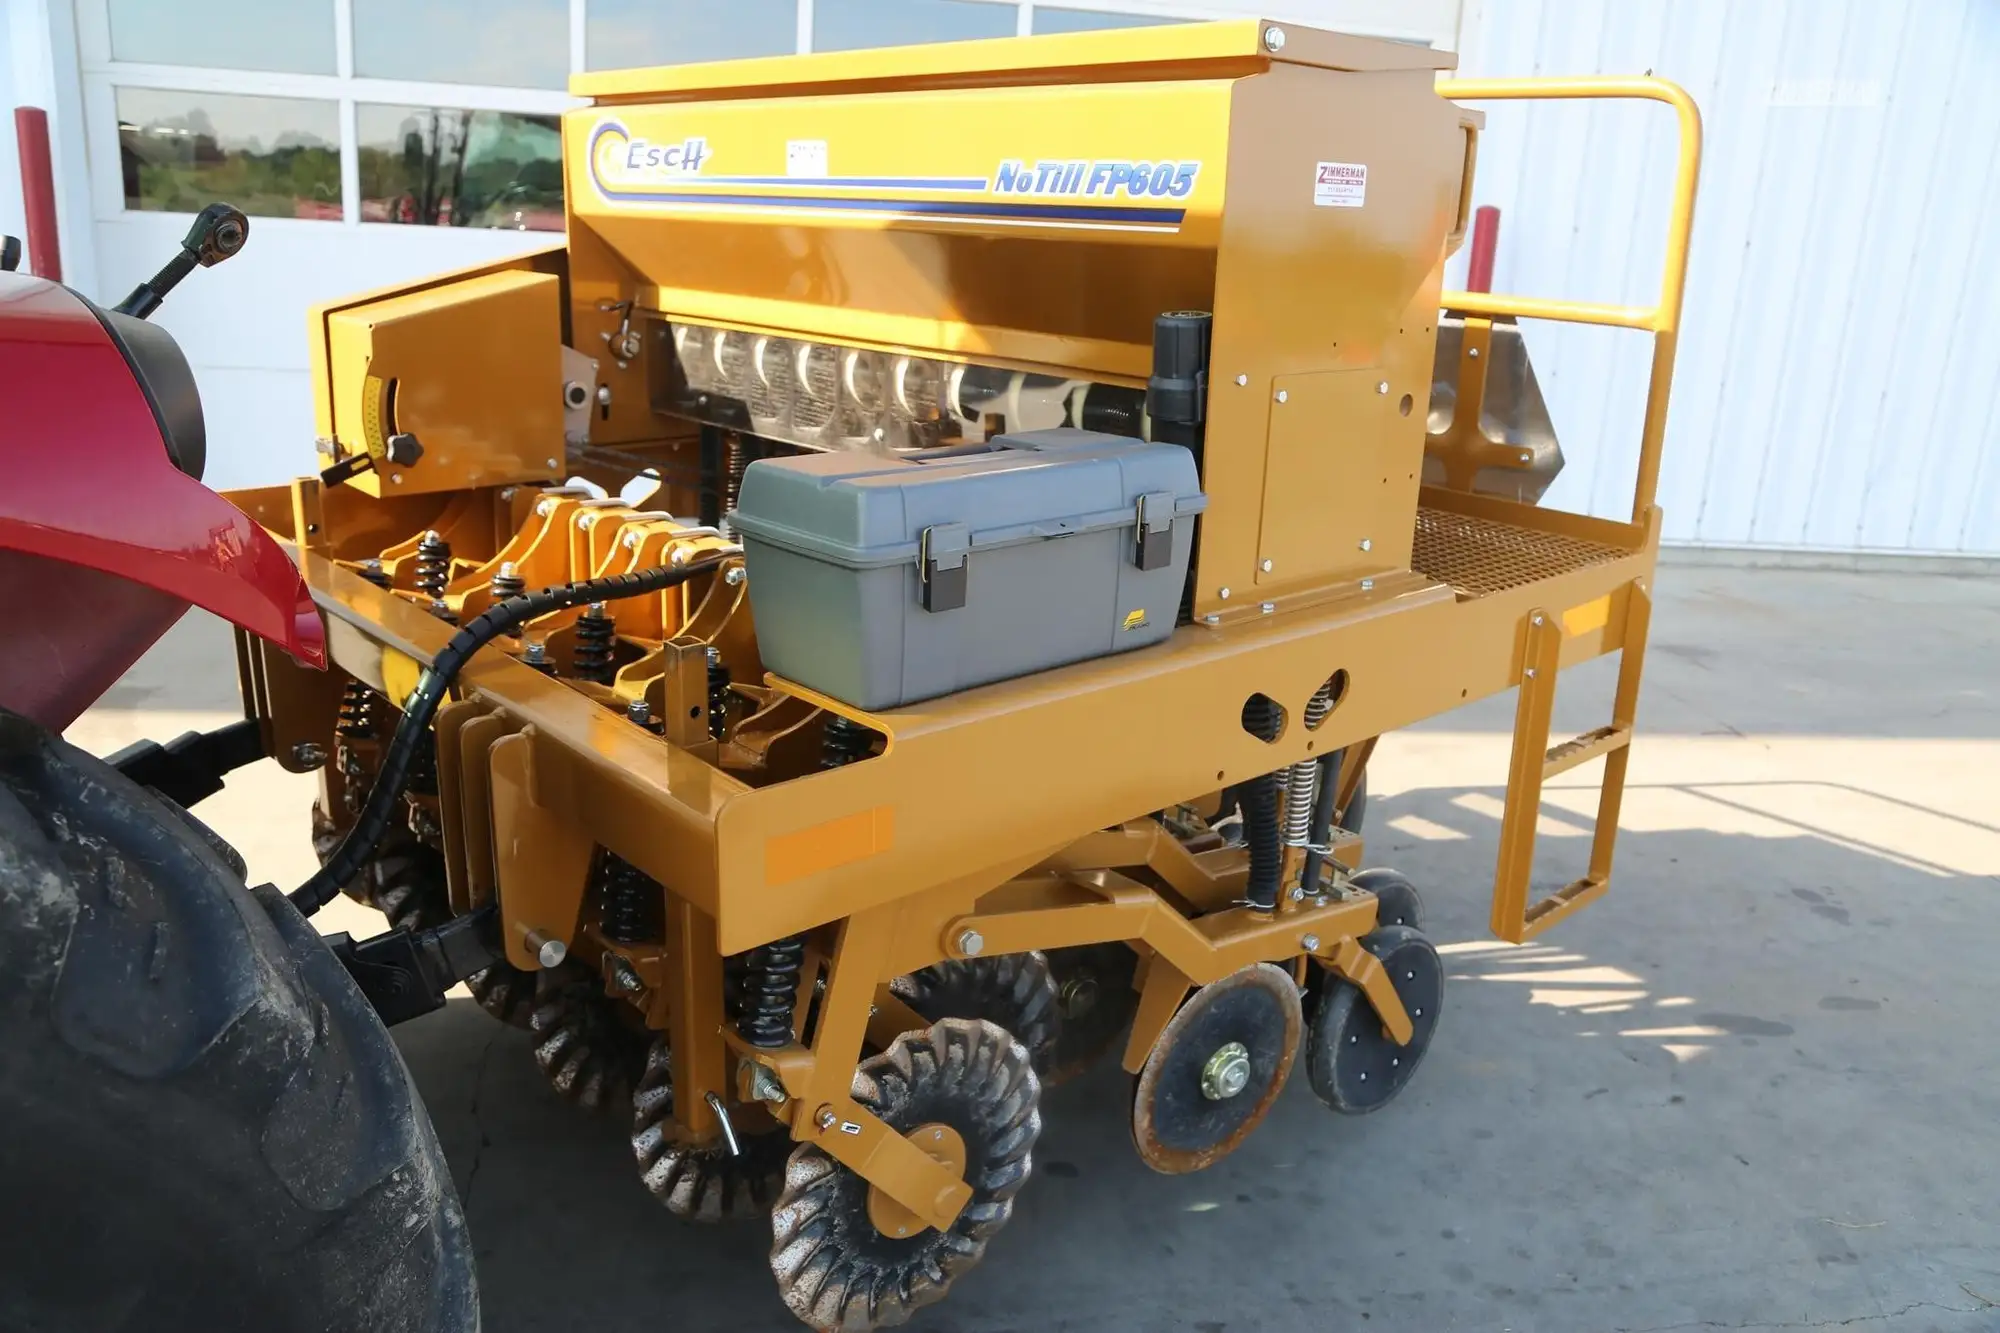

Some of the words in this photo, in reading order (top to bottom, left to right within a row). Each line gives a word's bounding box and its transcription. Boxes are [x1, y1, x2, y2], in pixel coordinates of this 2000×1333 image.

[995, 162, 1086, 193] NoTill
[1086, 162, 1199, 197] FP605
[1318, 166, 1365, 184] ZIMMERMAN
